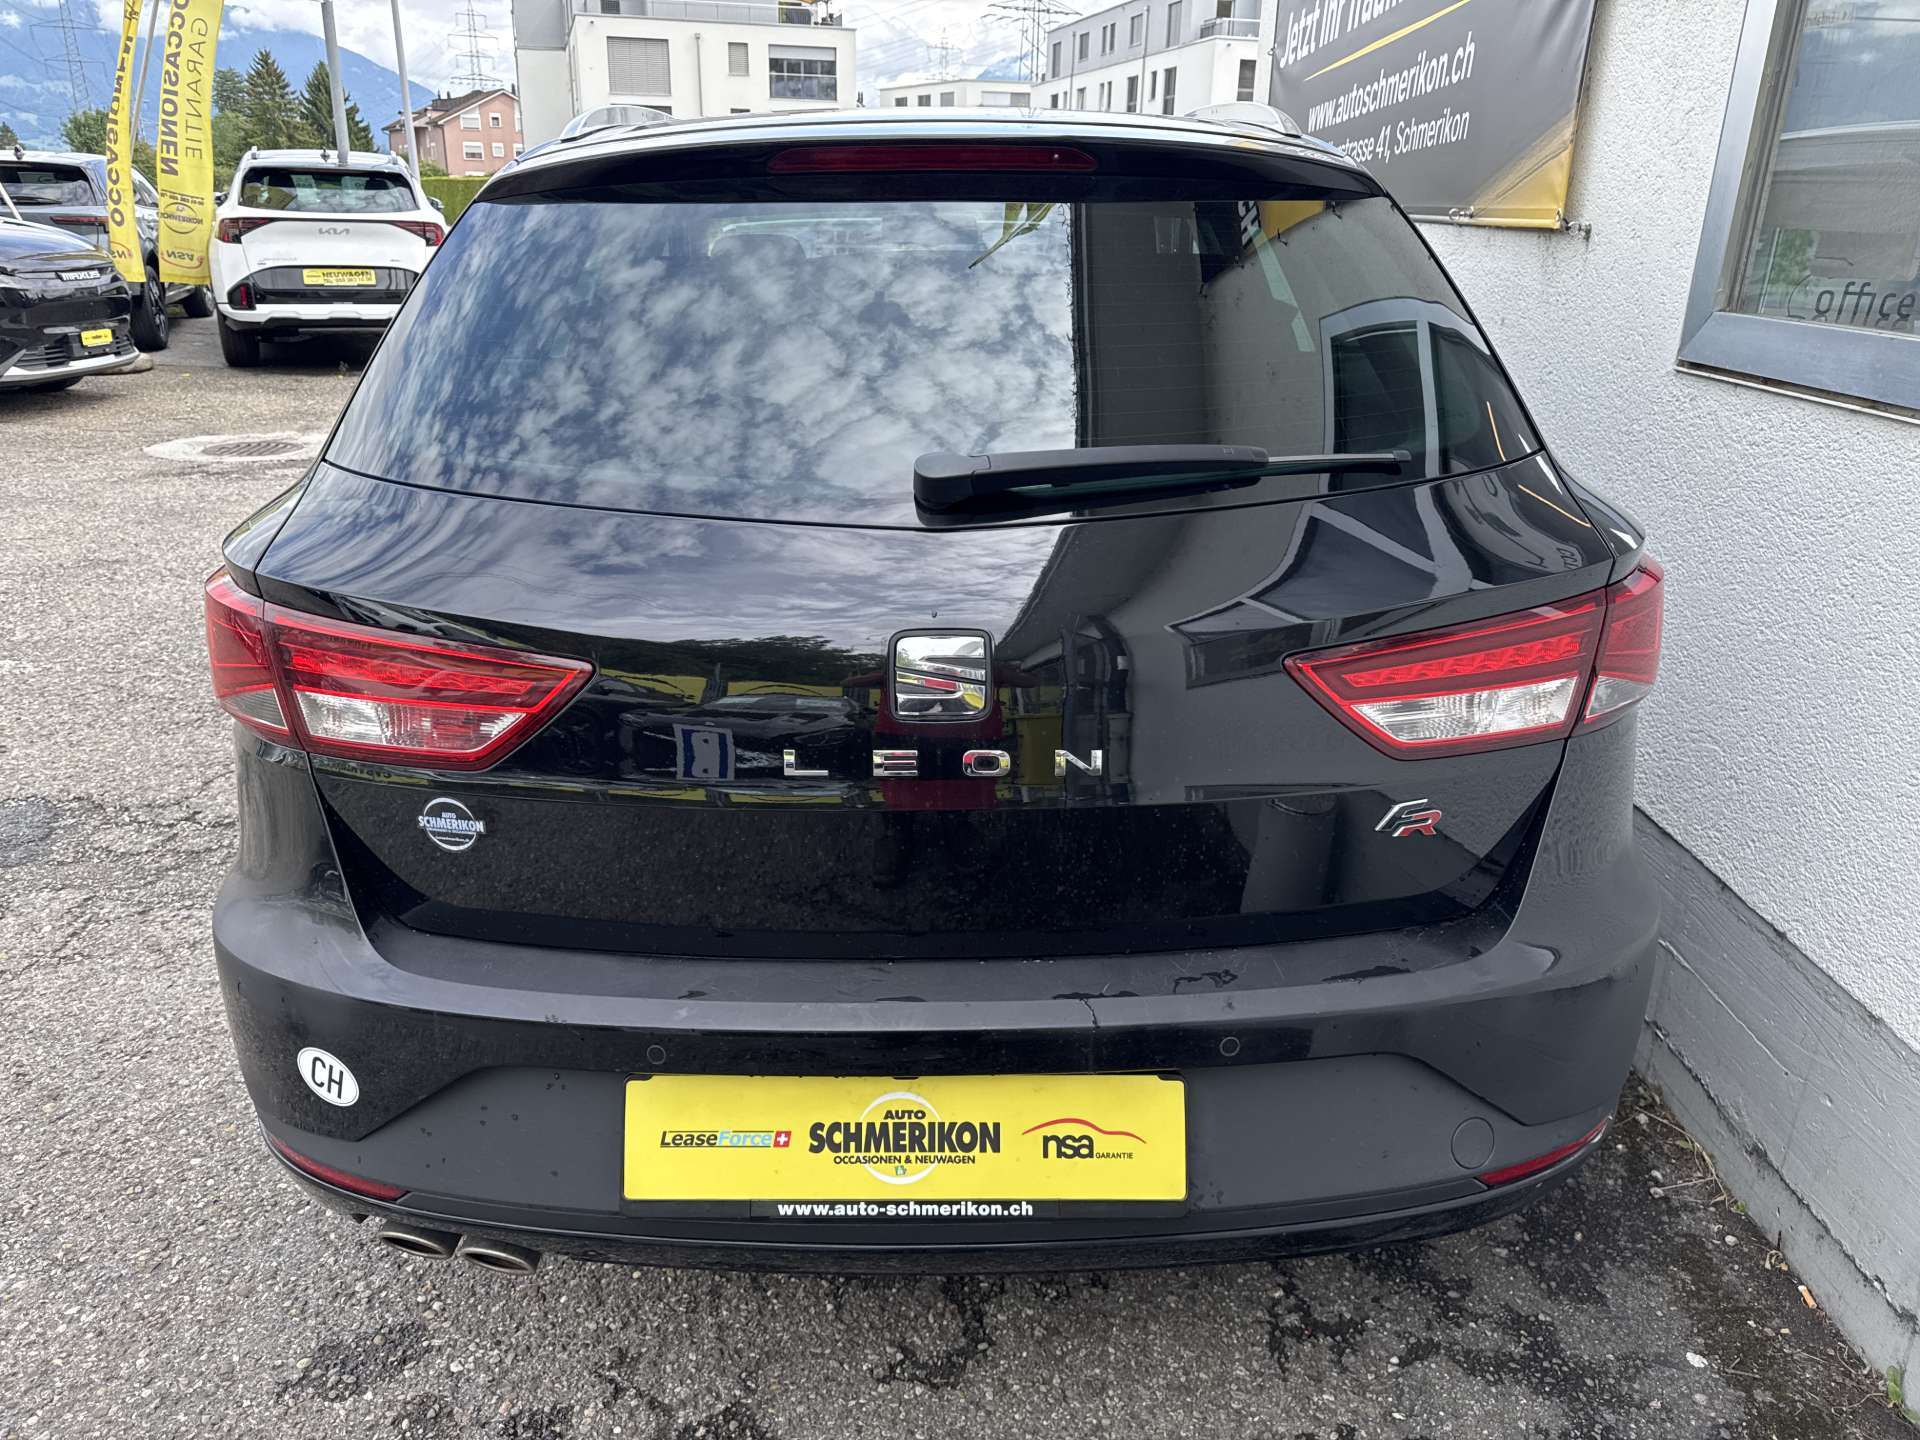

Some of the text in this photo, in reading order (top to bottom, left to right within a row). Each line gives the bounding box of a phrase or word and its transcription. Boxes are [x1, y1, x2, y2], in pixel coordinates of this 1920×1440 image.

[1279, 0, 1320, 68] Jetzt
[1307, 31, 1476, 133] www.autoschmerikon.ch
[1375, 124, 1392, 164] 41,
[1394, 109, 1471, 156] Schmerikon
[61, 269, 101, 281] MAXUS
[1814, 281, 1916, 323] office
[783, 749, 1102, 777] LEON
[418, 815, 485, 832] SCHMERIKON
[311, 1056, 344, 1099] CH
[883, 1109, 926, 1121] AUTO
[659, 1130, 773, 1148] LeaseForce
[808, 1121, 1001, 1154] SCHMERIKON
[1042, 1134, 1094, 1159] nsa
[833, 1155, 976, 1165] OCCASIONEN & NEUWAGEN
[1095, 1152, 1134, 1160] GARANTIE
[777, 1201, 1034, 1217] www.auto-schmerikon.ch
